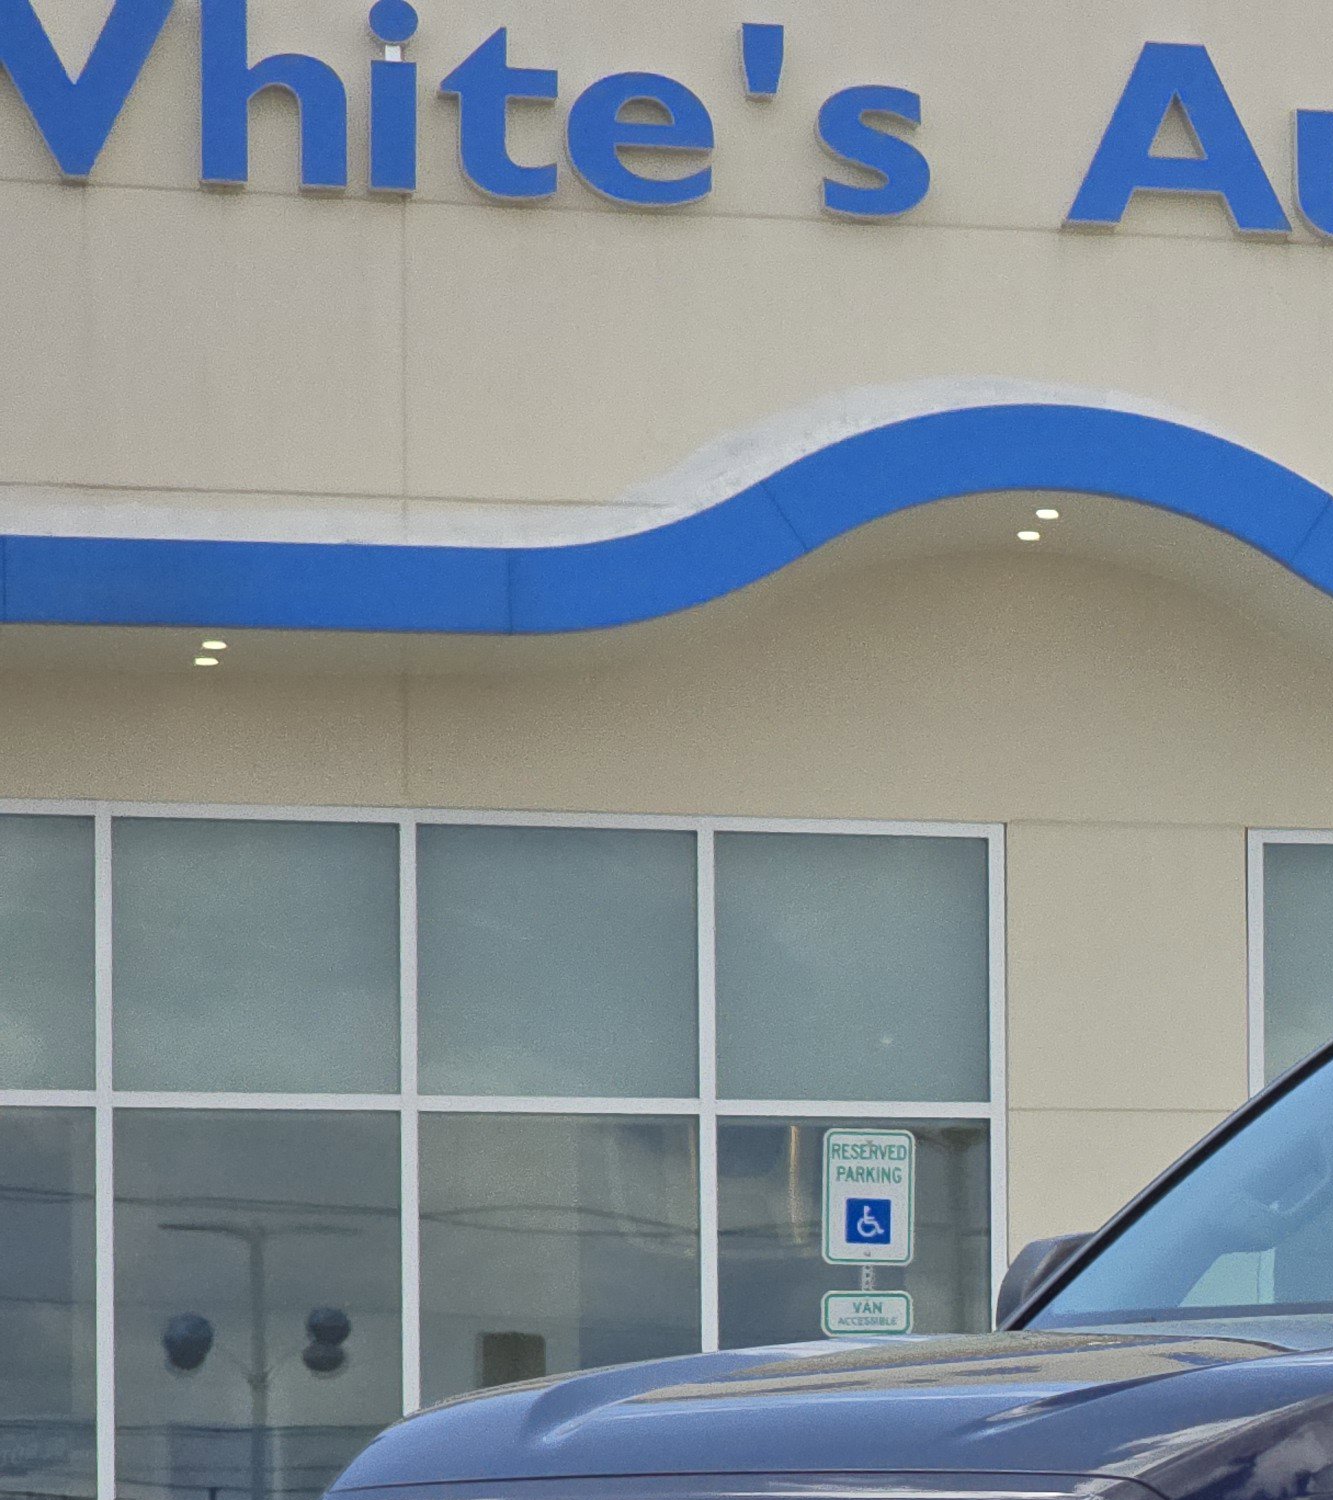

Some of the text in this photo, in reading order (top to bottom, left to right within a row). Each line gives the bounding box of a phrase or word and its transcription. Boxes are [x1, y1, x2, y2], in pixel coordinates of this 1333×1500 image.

[831, 1142, 907, 1161] RESERVED
[836, 1165, 903, 1184] PARKING
[852, 1302, 883, 1314] VAN
[837, 1315, 898, 1327] ACCESSIBLE
